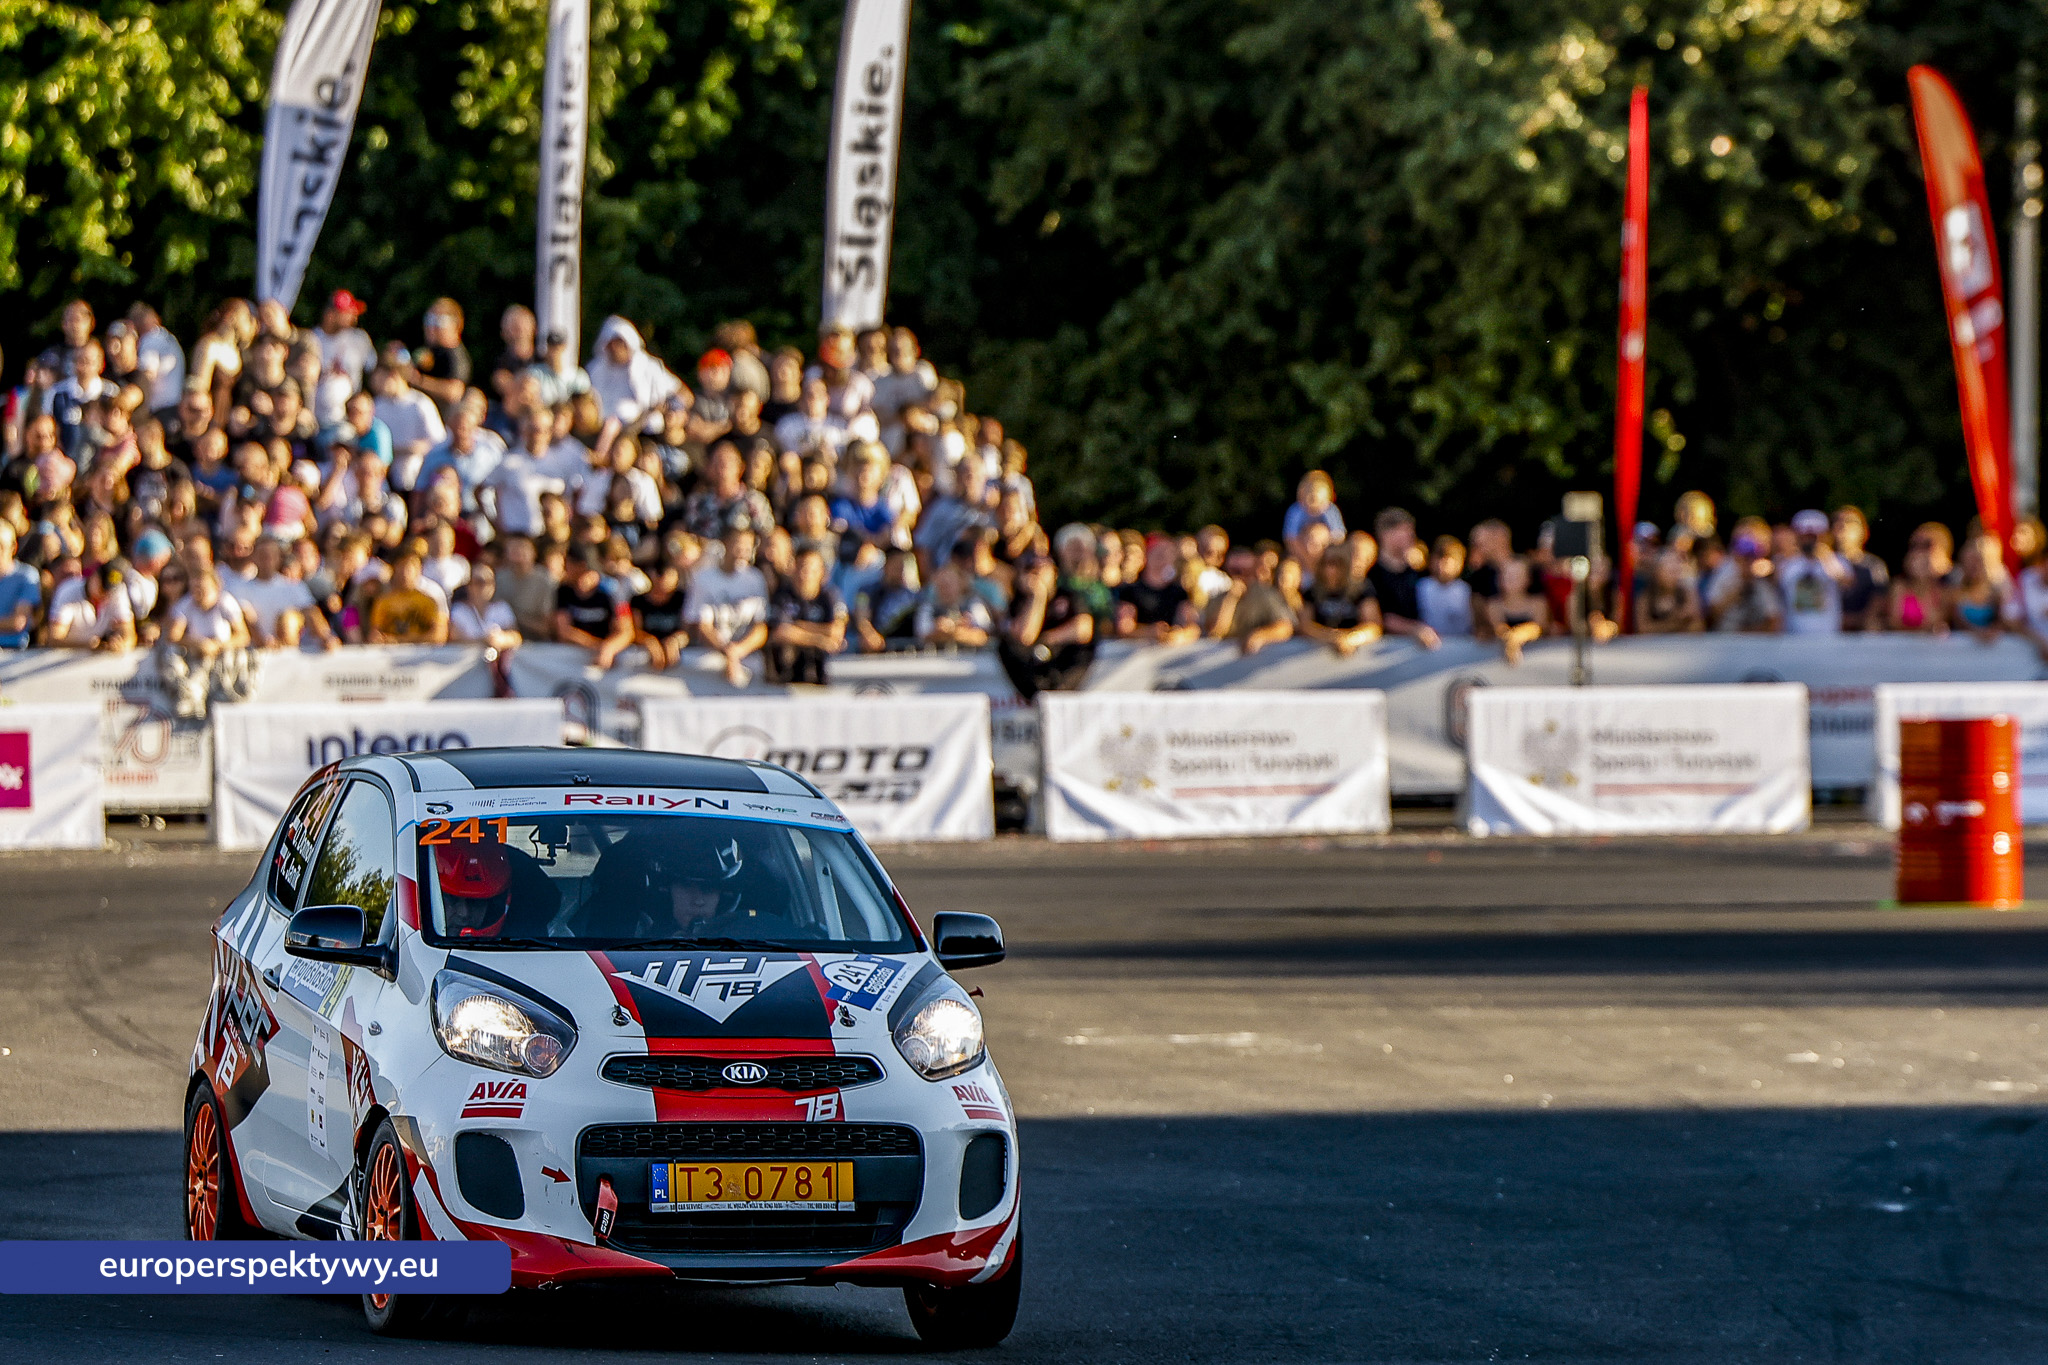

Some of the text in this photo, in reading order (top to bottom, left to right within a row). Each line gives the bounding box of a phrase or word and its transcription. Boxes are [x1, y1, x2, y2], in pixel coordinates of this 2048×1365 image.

[419, 816, 509, 847] 241
[833, 963, 871, 985] 241
[730, 1066, 761, 1079] KIA
[795, 1093, 839, 1122] 78
[654, 1189, 667, 1199] PL
[679, 1165, 833, 1201] T3 0781
